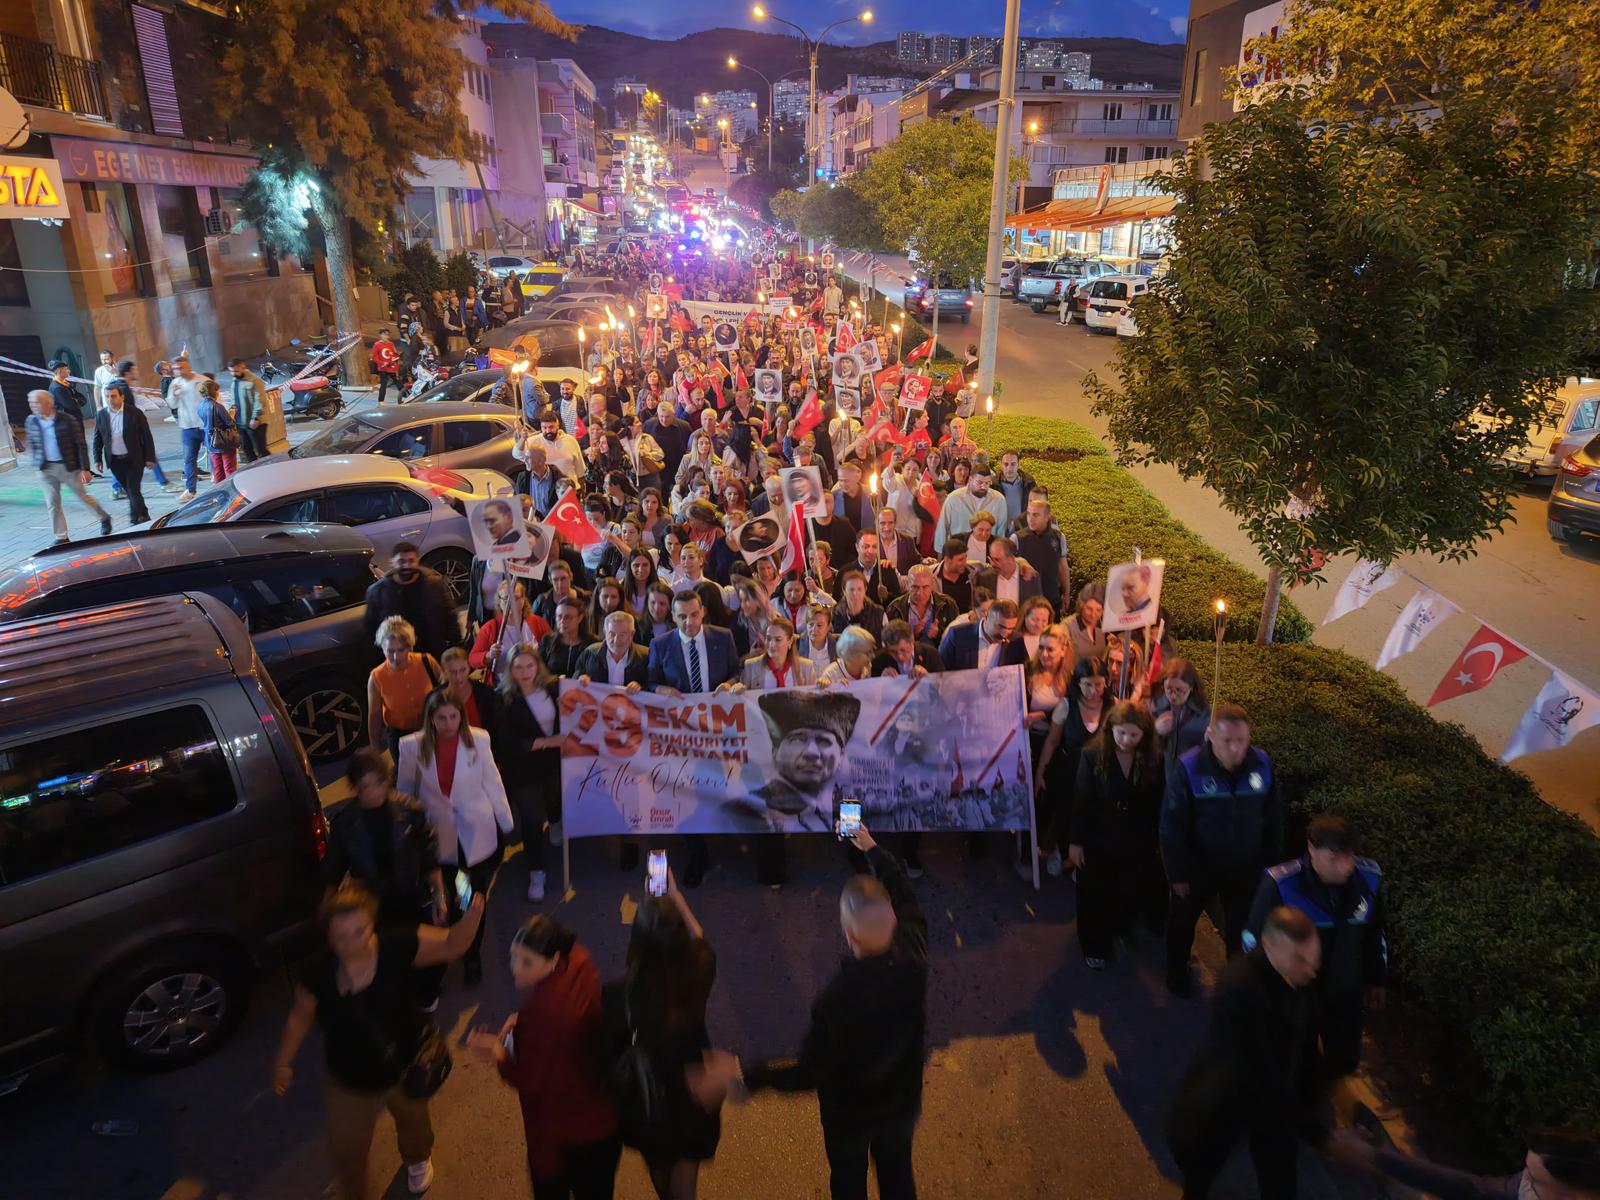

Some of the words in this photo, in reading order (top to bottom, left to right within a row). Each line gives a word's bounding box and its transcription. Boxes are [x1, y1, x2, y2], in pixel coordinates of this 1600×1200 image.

[94, 150, 132, 178] EGE
[134, 153, 166, 181] NET
[559, 688, 643, 757] 29
[649, 740, 749, 763] BAYRAMI
